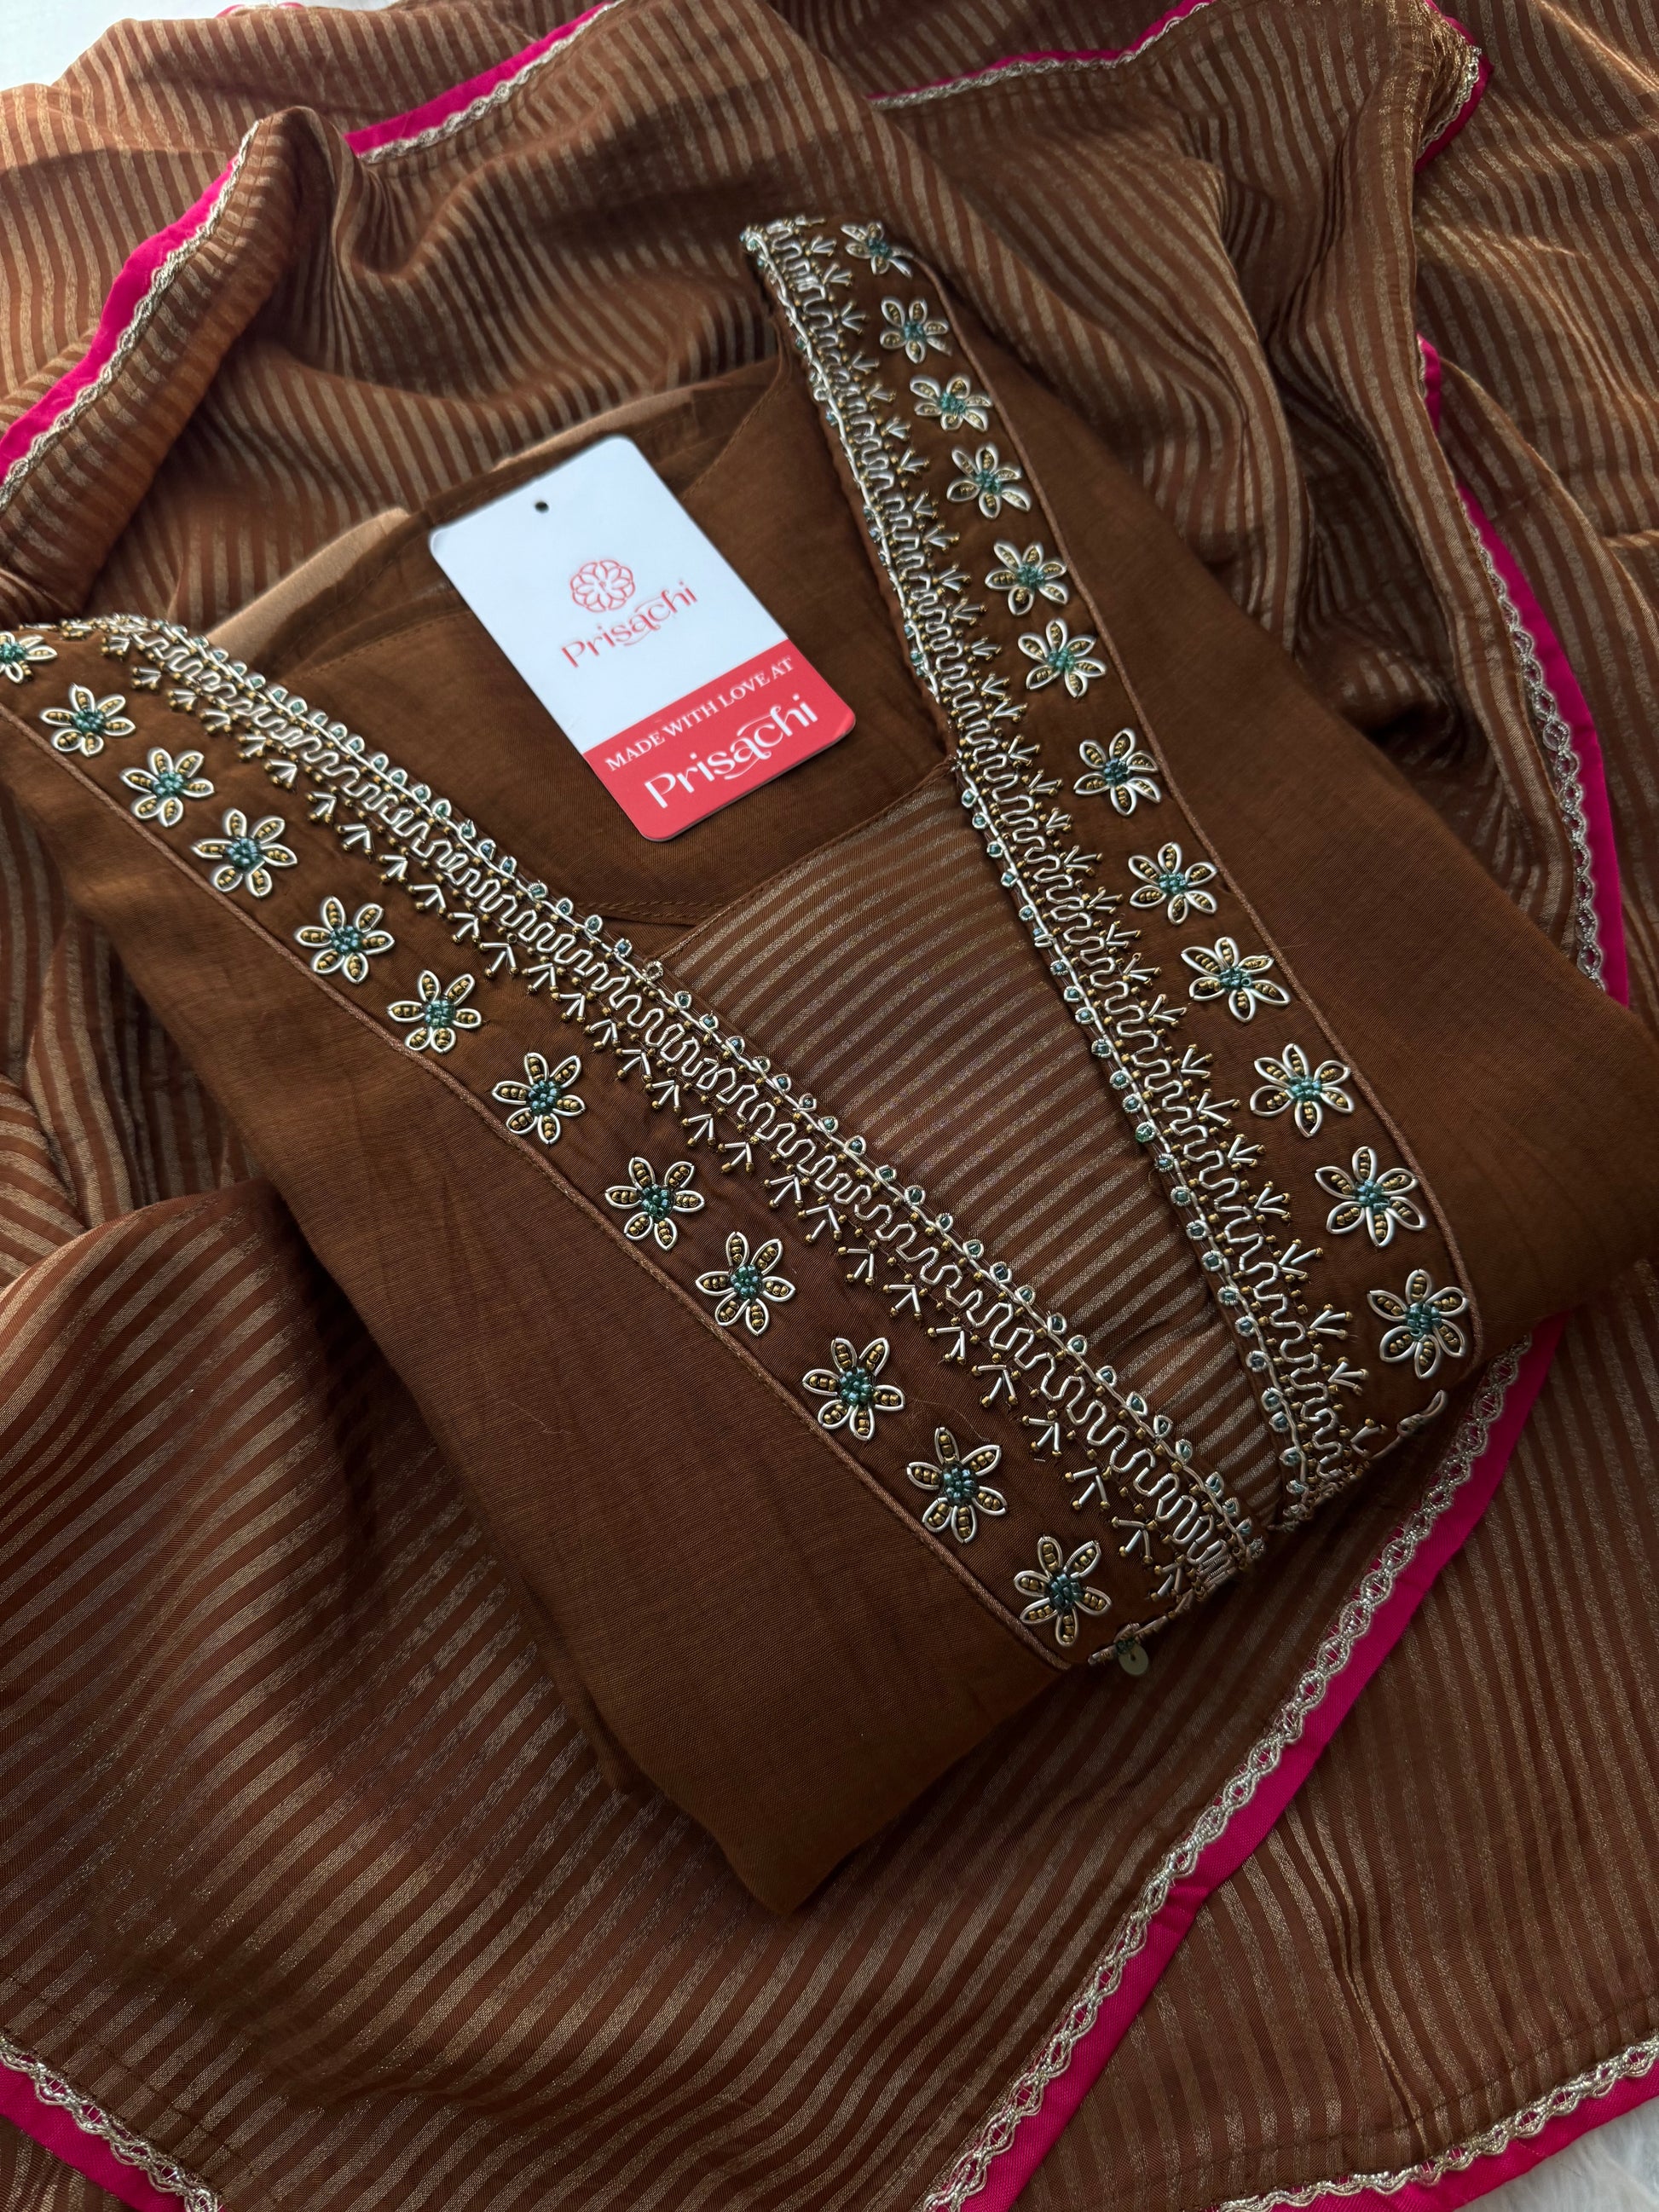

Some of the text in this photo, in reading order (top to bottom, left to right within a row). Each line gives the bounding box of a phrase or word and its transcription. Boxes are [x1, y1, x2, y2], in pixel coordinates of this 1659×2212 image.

[561, 581, 698, 667] Prisachi
[605, 656, 794, 771] MADE WITH LOVE AT
[644, 693, 818, 808] Prisachi
